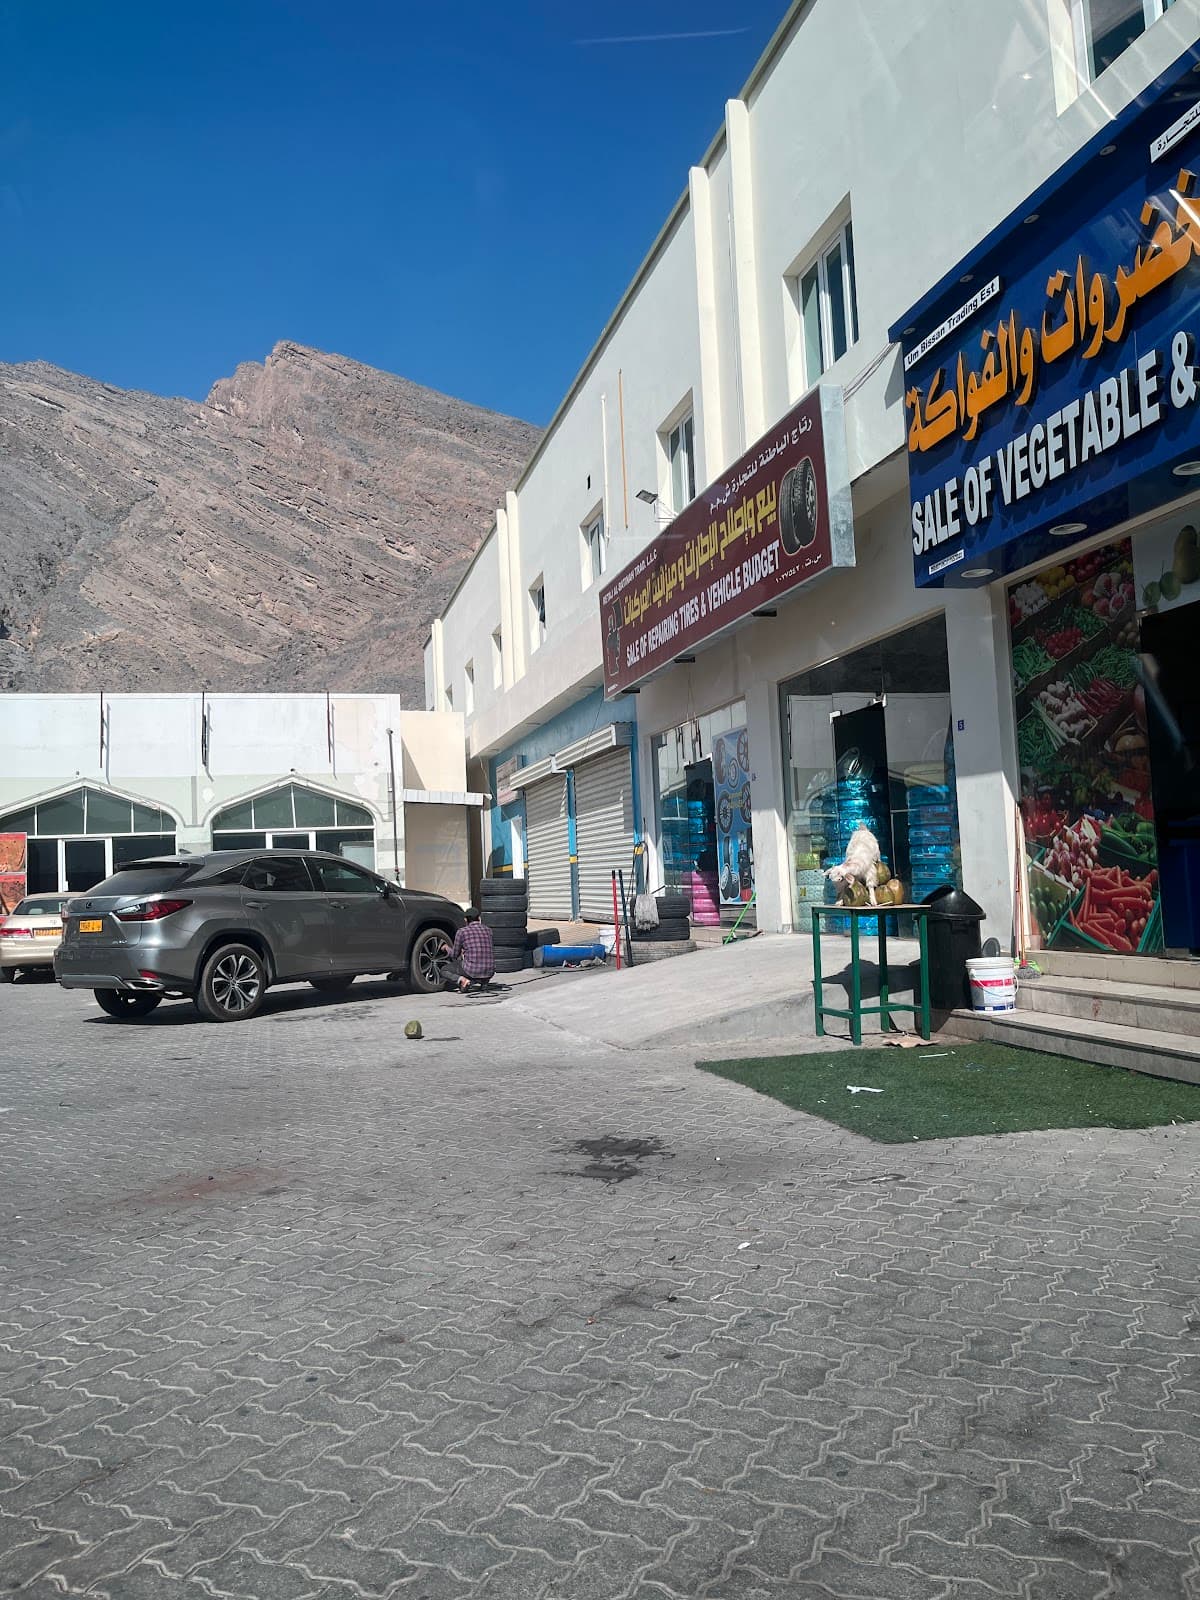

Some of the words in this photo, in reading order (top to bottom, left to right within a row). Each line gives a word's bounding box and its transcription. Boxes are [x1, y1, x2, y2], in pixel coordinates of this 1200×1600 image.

[907, 351, 919, 365] Um
[920, 327, 945, 354] Bissan
[947, 298, 978, 329] Trading
[980, 282, 995, 302] Est
[906, 308, 1034, 452] والفواكة
[731, 460, 758, 493] للتجارة
[758, 431, 790, 467] الباطنة
[912, 477, 960, 555] SALE
[963, 456, 992, 526] OF
[997, 350, 1160, 506] VEGETABLE
[1170, 331, 1197, 408] &
[756, 480, 777, 533] بيع
[623, 578, 652, 629] المركبات
[626, 639, 640, 668] SALE
[640, 633, 648, 659] OF
[647, 610, 679, 653] REPAIRING
[678, 595, 700, 632] TIRES
[701, 591, 707, 618] &
[706, 566, 742, 613] VEHICLE
[742, 538, 780, 590] BUDGET
